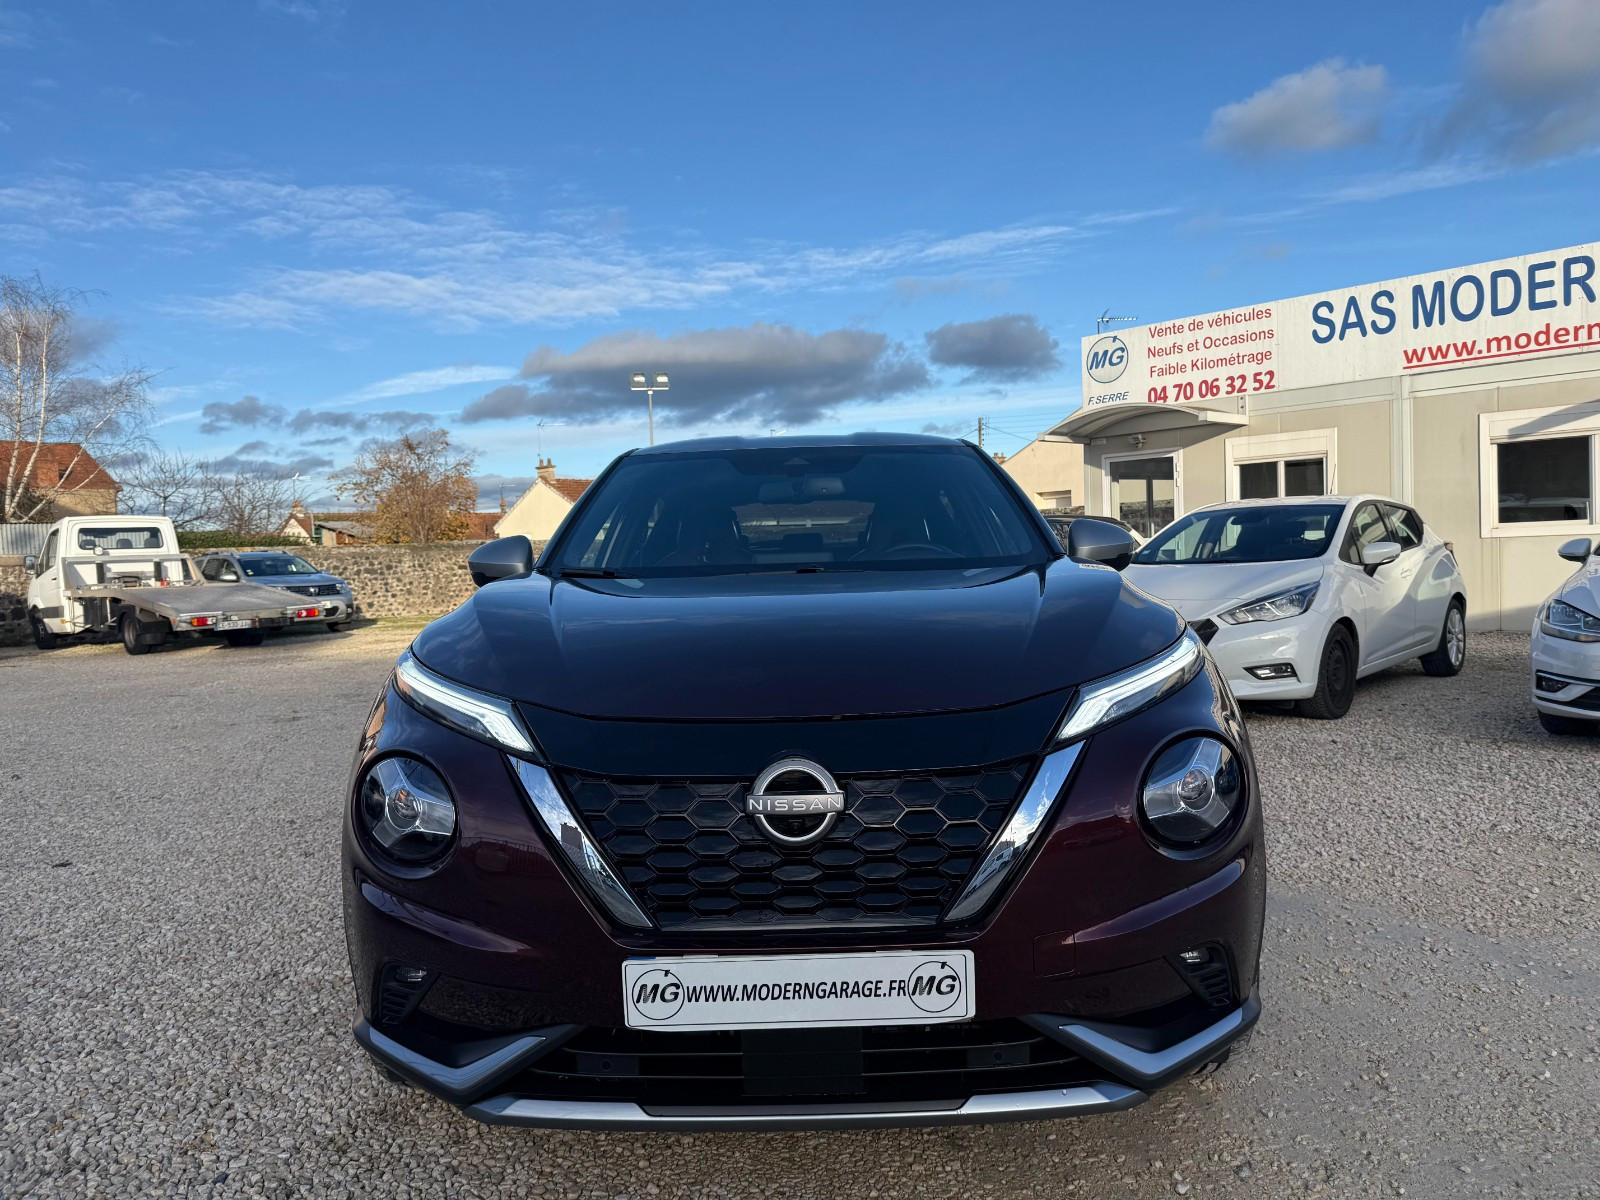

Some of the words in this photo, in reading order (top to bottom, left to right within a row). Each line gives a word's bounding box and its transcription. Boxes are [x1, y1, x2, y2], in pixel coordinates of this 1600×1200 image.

[1311, 289, 1397, 343] SAS
[1411, 255, 1597, 330] MODER
[1148, 323, 1184, 339] Vente
[1188, 318, 1204, 332] de
[1208, 308, 1272, 328] véhicules
[1147, 342, 1183, 359] Neufs
[1187, 338, 1199, 352] et
[1203, 328, 1275, 349] Occasions
[1089, 346, 1126, 371] MG
[1150, 361, 1187, 378] Faible
[1191, 350, 1273, 372] Kilométrage
[1147, 386, 1169, 403] 04
[1172, 381, 1194, 402] 70
[1198, 378, 1221, 398] 06
[1225, 374, 1248, 395] 32
[1252, 370, 1276, 391] 52
[749, 795, 843, 812] NISSAN
[635, 982, 681, 1004] MG
[685, 979, 908, 1003] WWW.MODERNGARAGE.FR
[911, 974, 958, 996] MG
